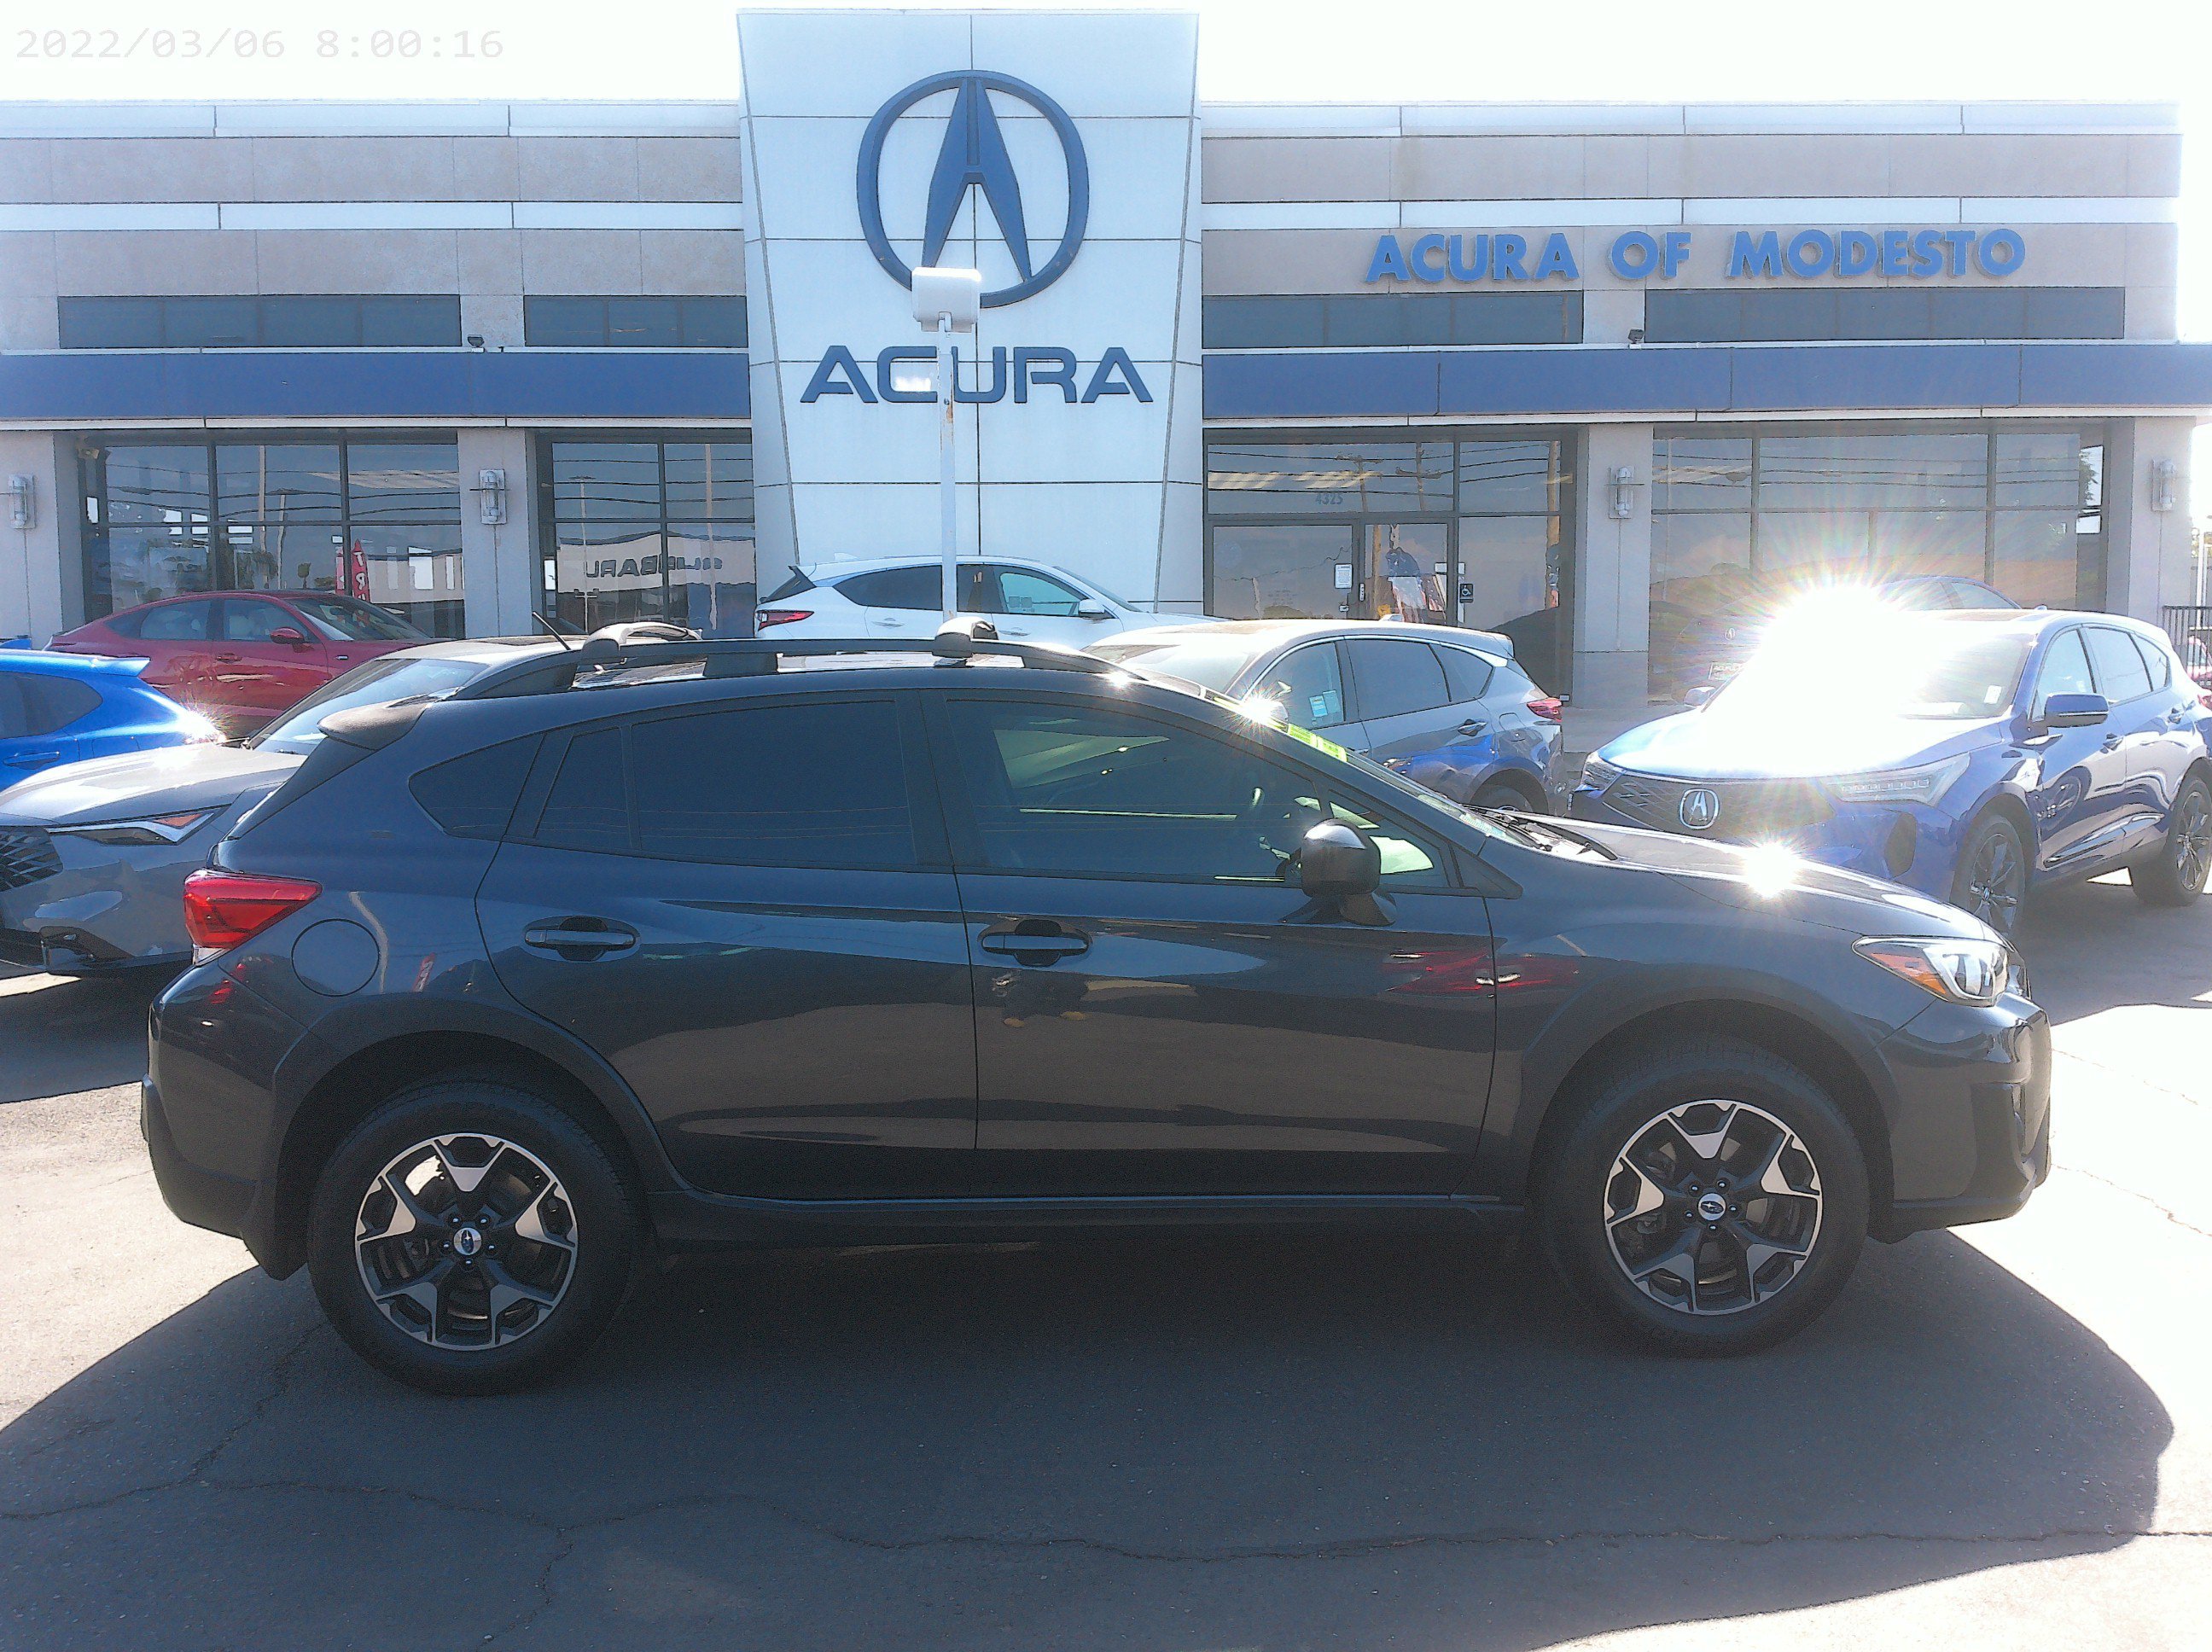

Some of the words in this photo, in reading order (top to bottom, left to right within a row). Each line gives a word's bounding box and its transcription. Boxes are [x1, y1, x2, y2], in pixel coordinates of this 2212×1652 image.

[1365, 233, 1580, 282] ACURA
[1610, 230, 1691, 280] OF
[1728, 228, 2026, 278] MODESTO
[800, 345, 1154, 404] ACURA
[1316, 492, 1343, 505] 4325
